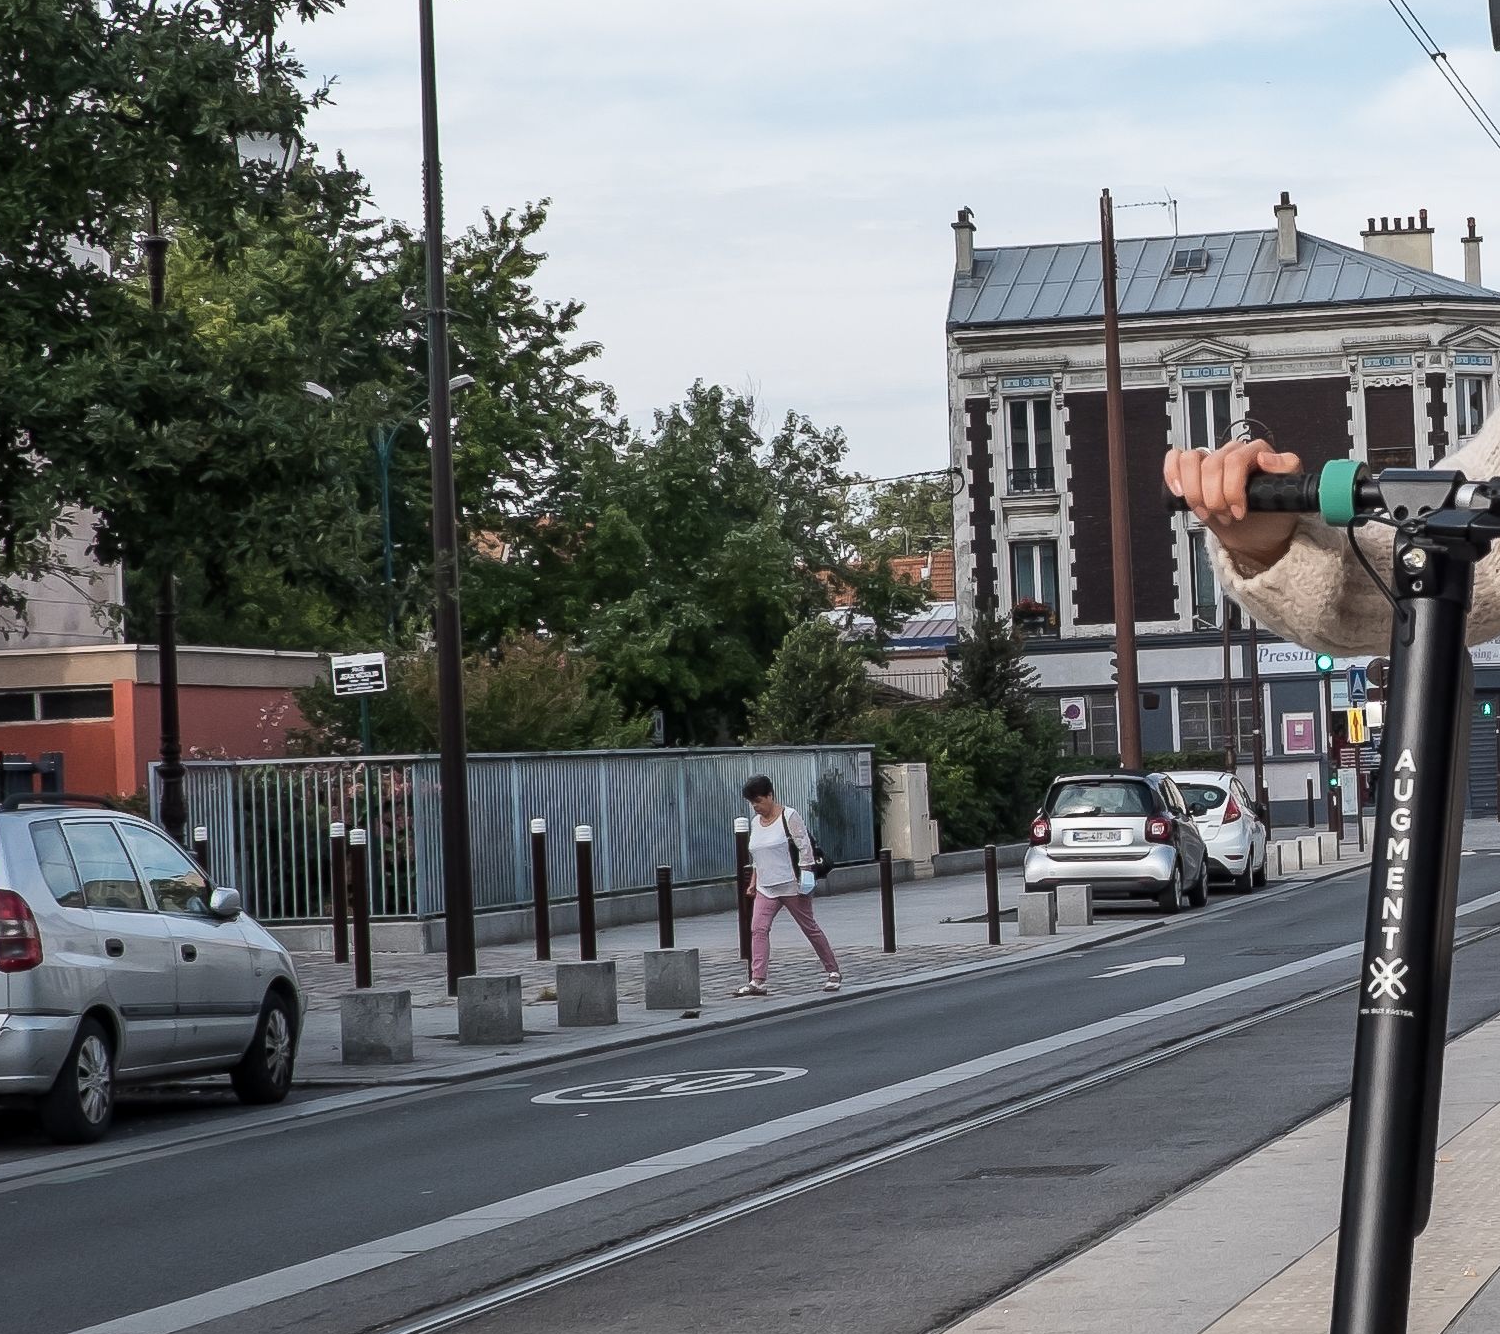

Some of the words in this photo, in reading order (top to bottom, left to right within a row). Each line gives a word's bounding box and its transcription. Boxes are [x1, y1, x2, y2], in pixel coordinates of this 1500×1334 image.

[1258, 647, 1316, 663] Pressin
[1381, 748, 1417, 951] AUGMENT
[581, 1072, 758, 1098] 30
